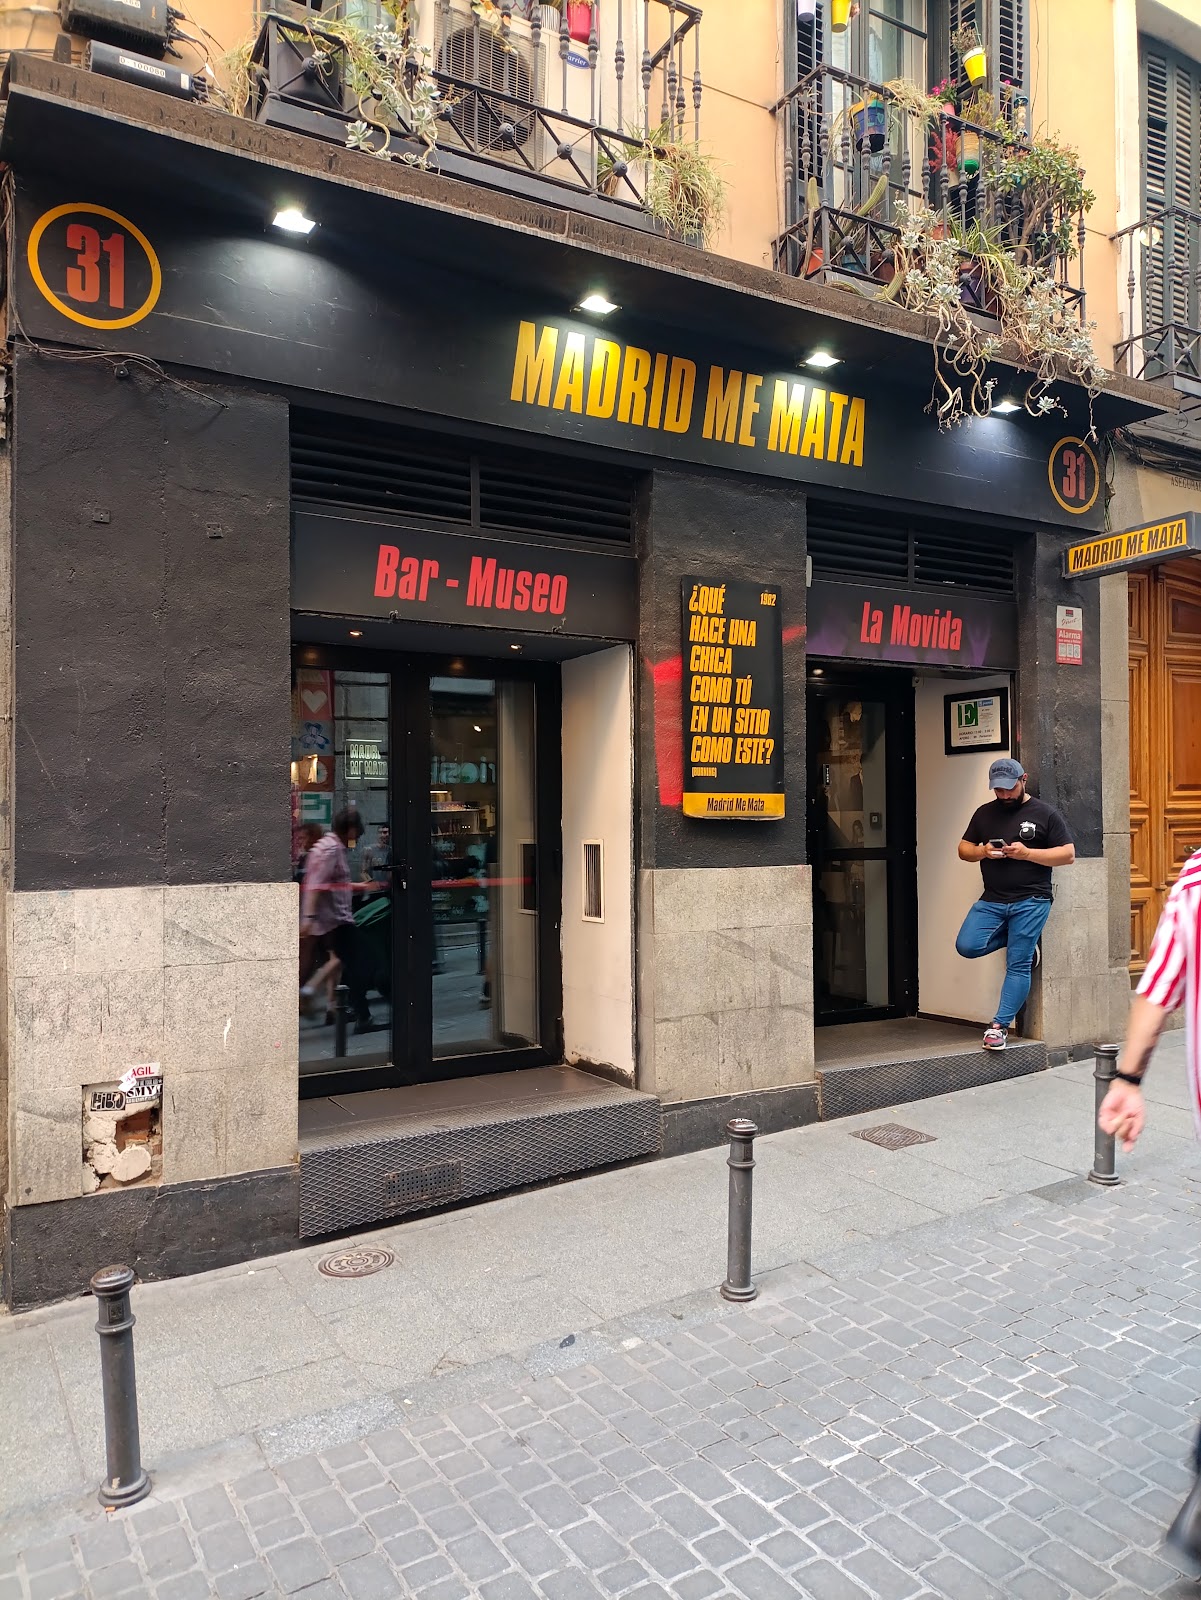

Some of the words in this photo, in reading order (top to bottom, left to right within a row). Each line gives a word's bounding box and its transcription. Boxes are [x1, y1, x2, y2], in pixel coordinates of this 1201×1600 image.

[566, 54, 587, 66] arrier
[66, 223, 125, 309] 31
[510, 320, 697, 434] MADRID
[702, 365, 764, 447] ME
[767, 379, 866, 467] MATA
[1063, 449, 1086, 500] 31
[1072, 538, 1123, 570] MADRID
[1125, 532, 1145, 557] ME
[1147, 522, 1183, 551] MATA
[374, 544, 440, 602] Bar
[466, 555, 568, 615] Museo
[689, 584, 726, 616] ¿QUÉ
[760, 592, 776, 607] 1982
[689, 615, 727, 644] HACE
[729, 619, 757, 647] UNA
[860, 601, 884, 644] La
[890, 604, 963, 651] Movida
[1058, 630, 1081, 640] Alarma
[690, 645, 733, 675] CHICA
[690, 676, 732, 704] COMO
[735, 675, 753, 705] TÚ
[690, 706, 709, 733] EN
[712, 707, 732, 734] UN
[734, 708, 770, 736] SITIO
[959, 703, 976, 727] E
[690, 736, 733, 764] COMO
[735, 737, 775, 766] ESTE?
[707, 797, 734, 812] Madrid
[735, 797, 747, 812] Me
[747, 797, 765, 812] Mata
